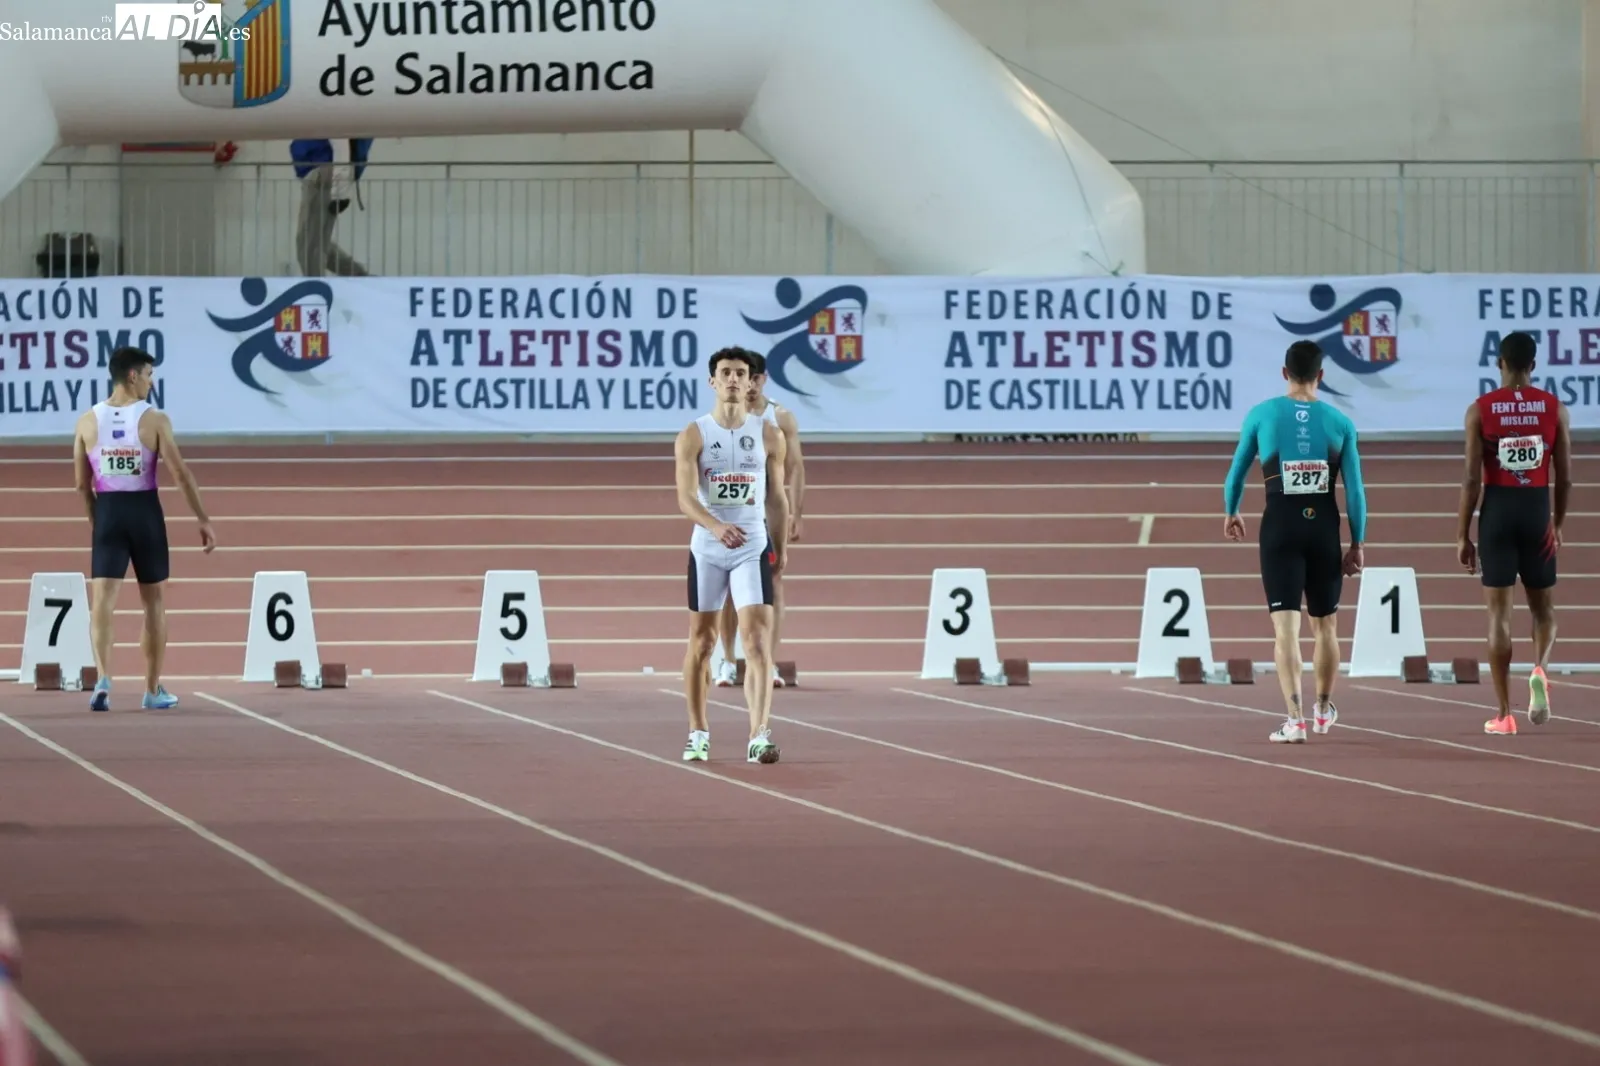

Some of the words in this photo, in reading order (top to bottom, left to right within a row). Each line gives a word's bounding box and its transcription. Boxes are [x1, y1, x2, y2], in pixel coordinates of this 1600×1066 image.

[318, 0, 656, 48] Ayuntamiento
[319, 54, 374, 97] de
[395, 52, 654, 96] Salamanca
[123, 286, 164, 319] DE
[409, 281, 631, 320] FEDERACIÓN
[658, 287, 698, 319] DE
[944, 282, 1167, 320] FEDERACIÓN
[1192, 290, 1233, 320] DE
[0, 328, 165, 370] TISMO
[410, 329, 698, 367] ATLETISMO
[944, 329, 1233, 368] ATLETISMO
[1479, 328, 1600, 367] ALE
[65, 379, 82, 411] Y
[410, 377, 447, 409] DE
[455, 377, 589, 410] CASTILLA
[597, 378, 616, 410] Y
[623, 371, 698, 410] LEÓN
[945, 379, 982, 410] DE
[989, 378, 1125, 410] CASTILLA
[1131, 379, 1150, 410] Y
[1157, 372, 1233, 410] LEÓN
[1491, 402, 1516, 414] FENT
[1518, 400, 1546, 413] CAMÍ
[1500, 415, 1539, 426] MISLATA
[108, 456, 135, 470] 185
[1508, 447, 1537, 463] 280
[718, 483, 750, 499] 257
[1292, 471, 1322, 486] 287
[44, 598, 73, 647] 7
[265, 592, 295, 642] 6
[500, 592, 528, 641] 5
[942, 587, 974, 636] 3
[1161, 588, 1191, 638] 2
[1380, 585, 1401, 635] 1
